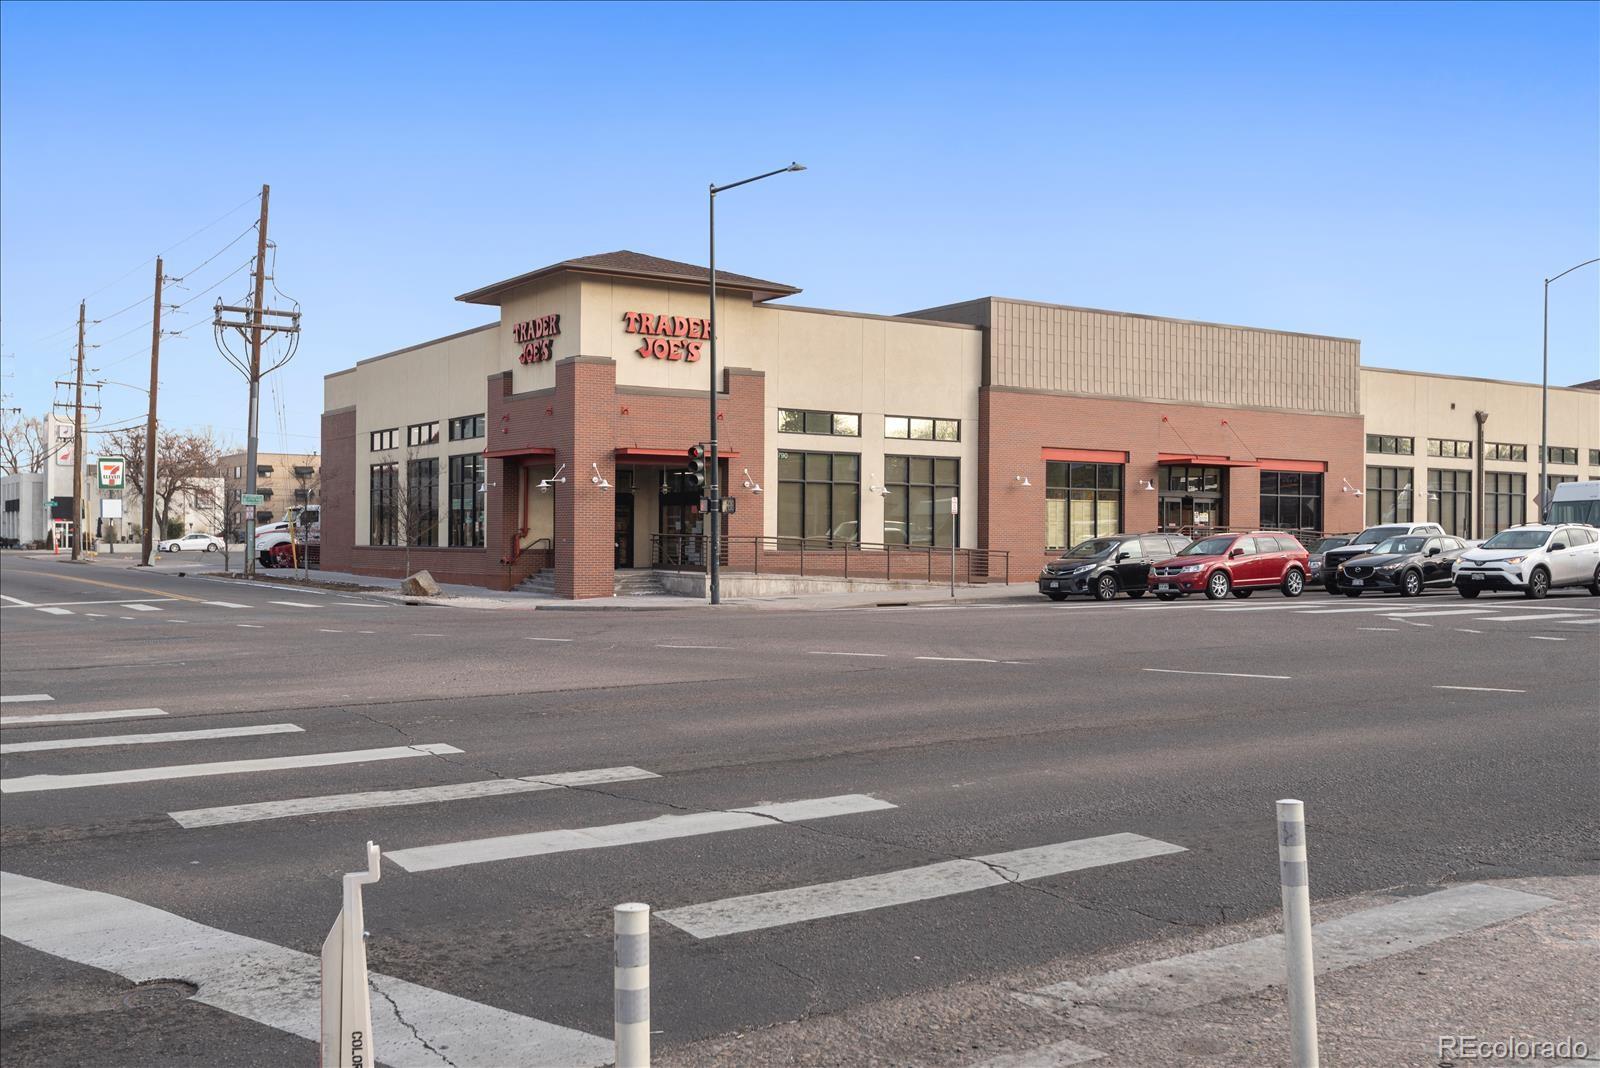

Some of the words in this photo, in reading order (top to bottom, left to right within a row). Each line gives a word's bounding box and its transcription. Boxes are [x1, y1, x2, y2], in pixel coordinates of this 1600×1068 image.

[513, 314, 561, 343] TRADER
[519, 339, 553, 364] JOE'S
[635, 337, 703, 362] JOE'S
